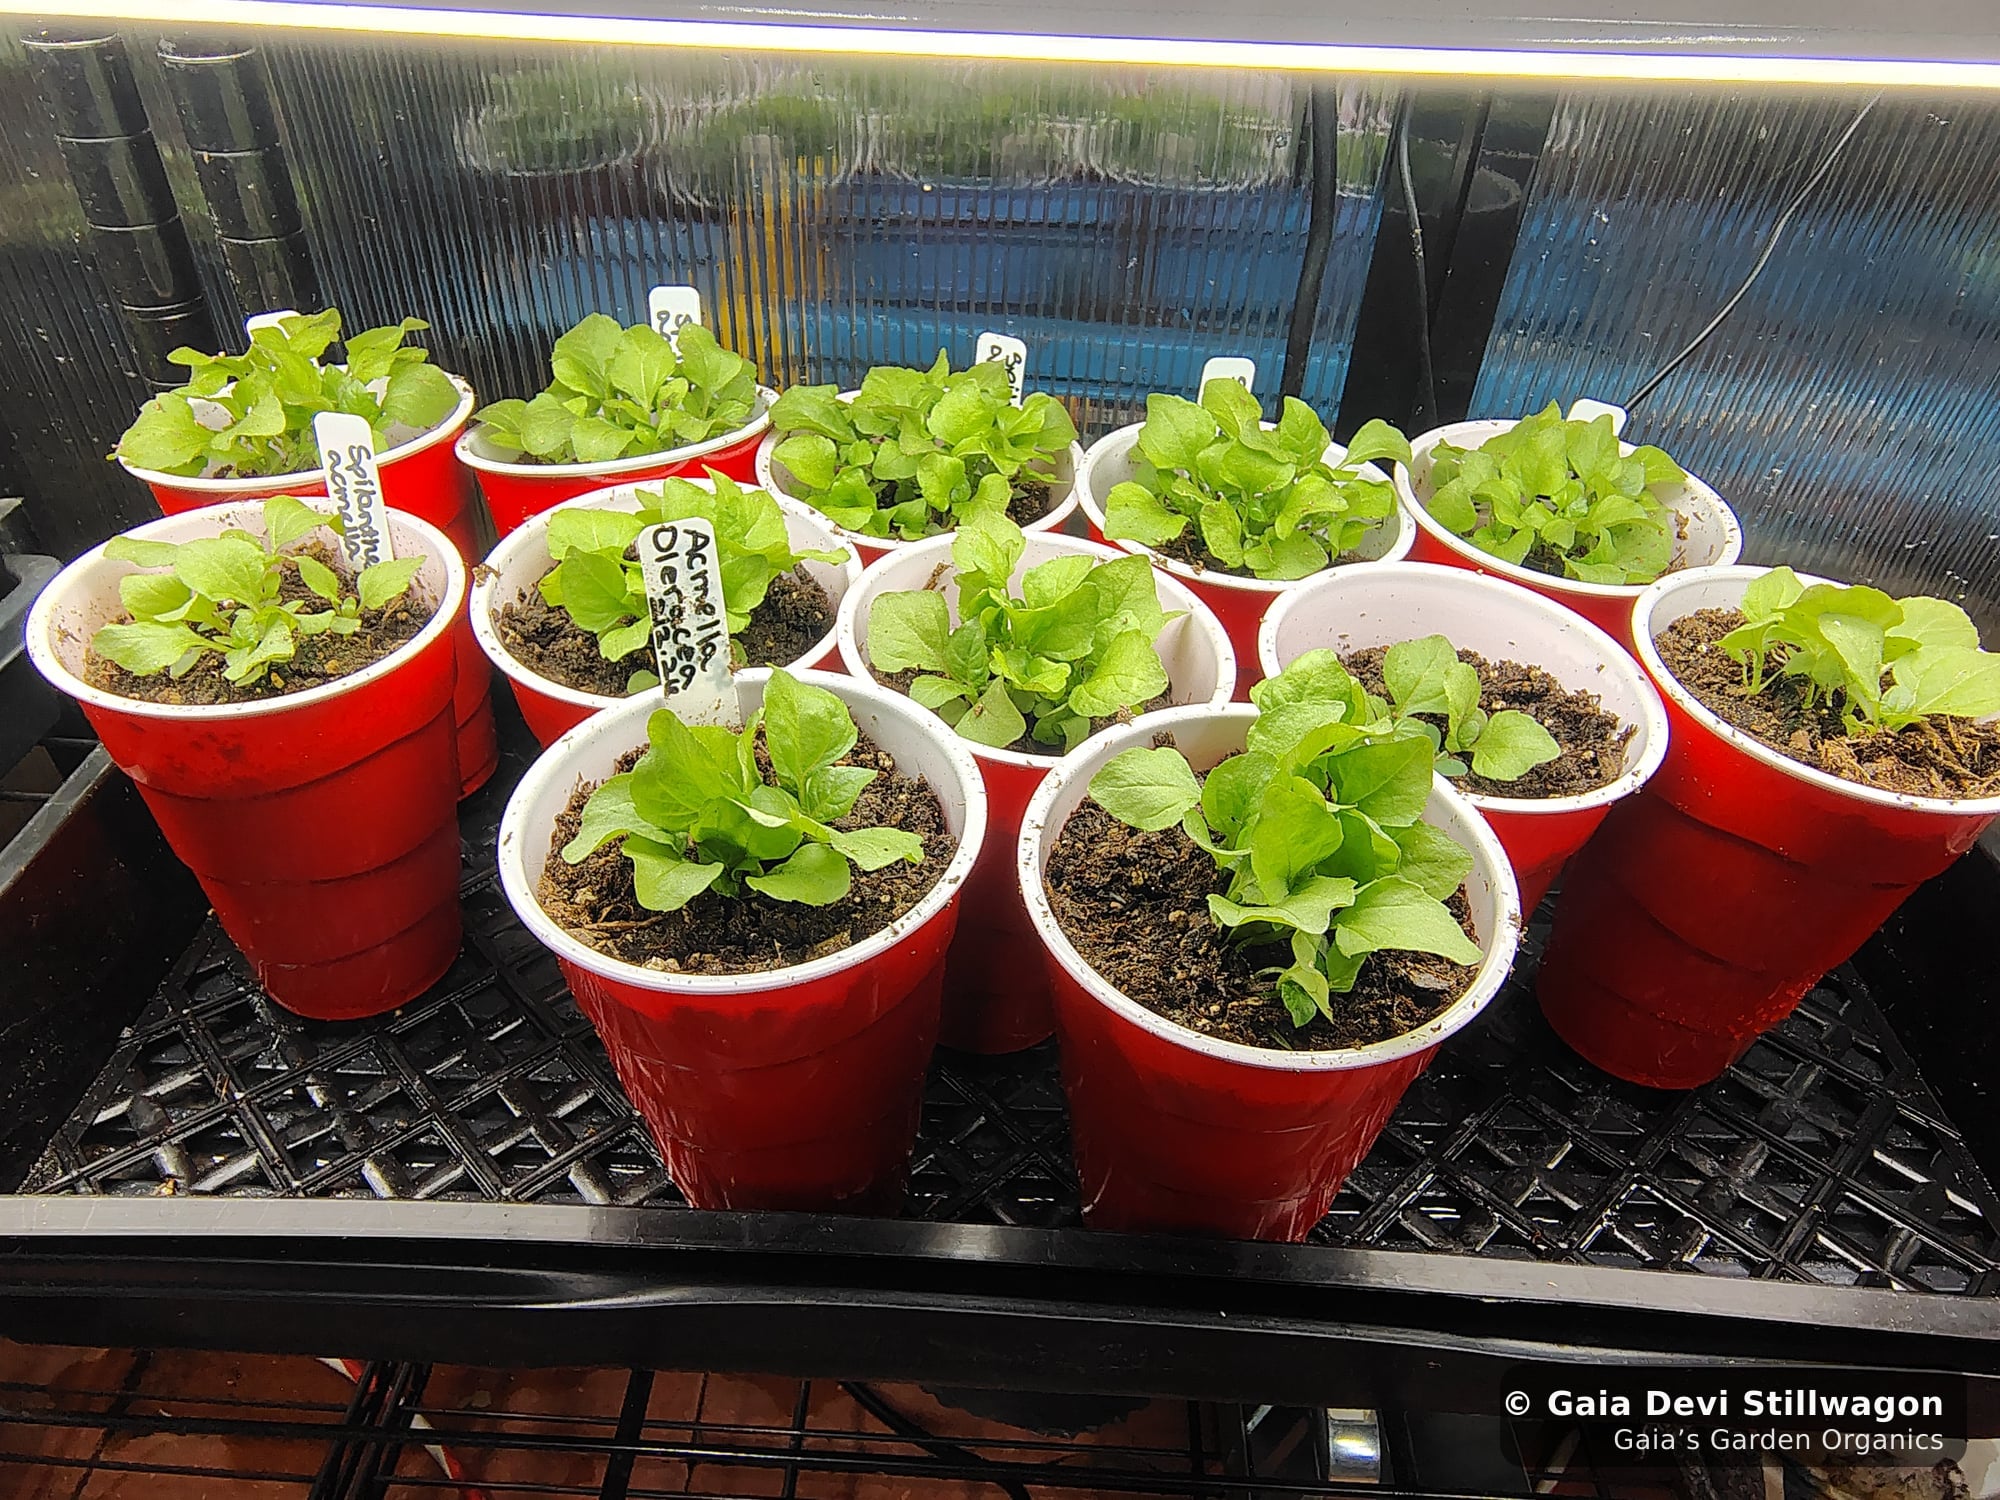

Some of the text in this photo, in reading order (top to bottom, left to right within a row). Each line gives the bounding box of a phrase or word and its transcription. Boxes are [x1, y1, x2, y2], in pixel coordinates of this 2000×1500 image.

[345, 445, 380, 569] Spilanthe
[652, 525, 696, 690] Oleracea
[683, 528, 721, 672] Acmella
